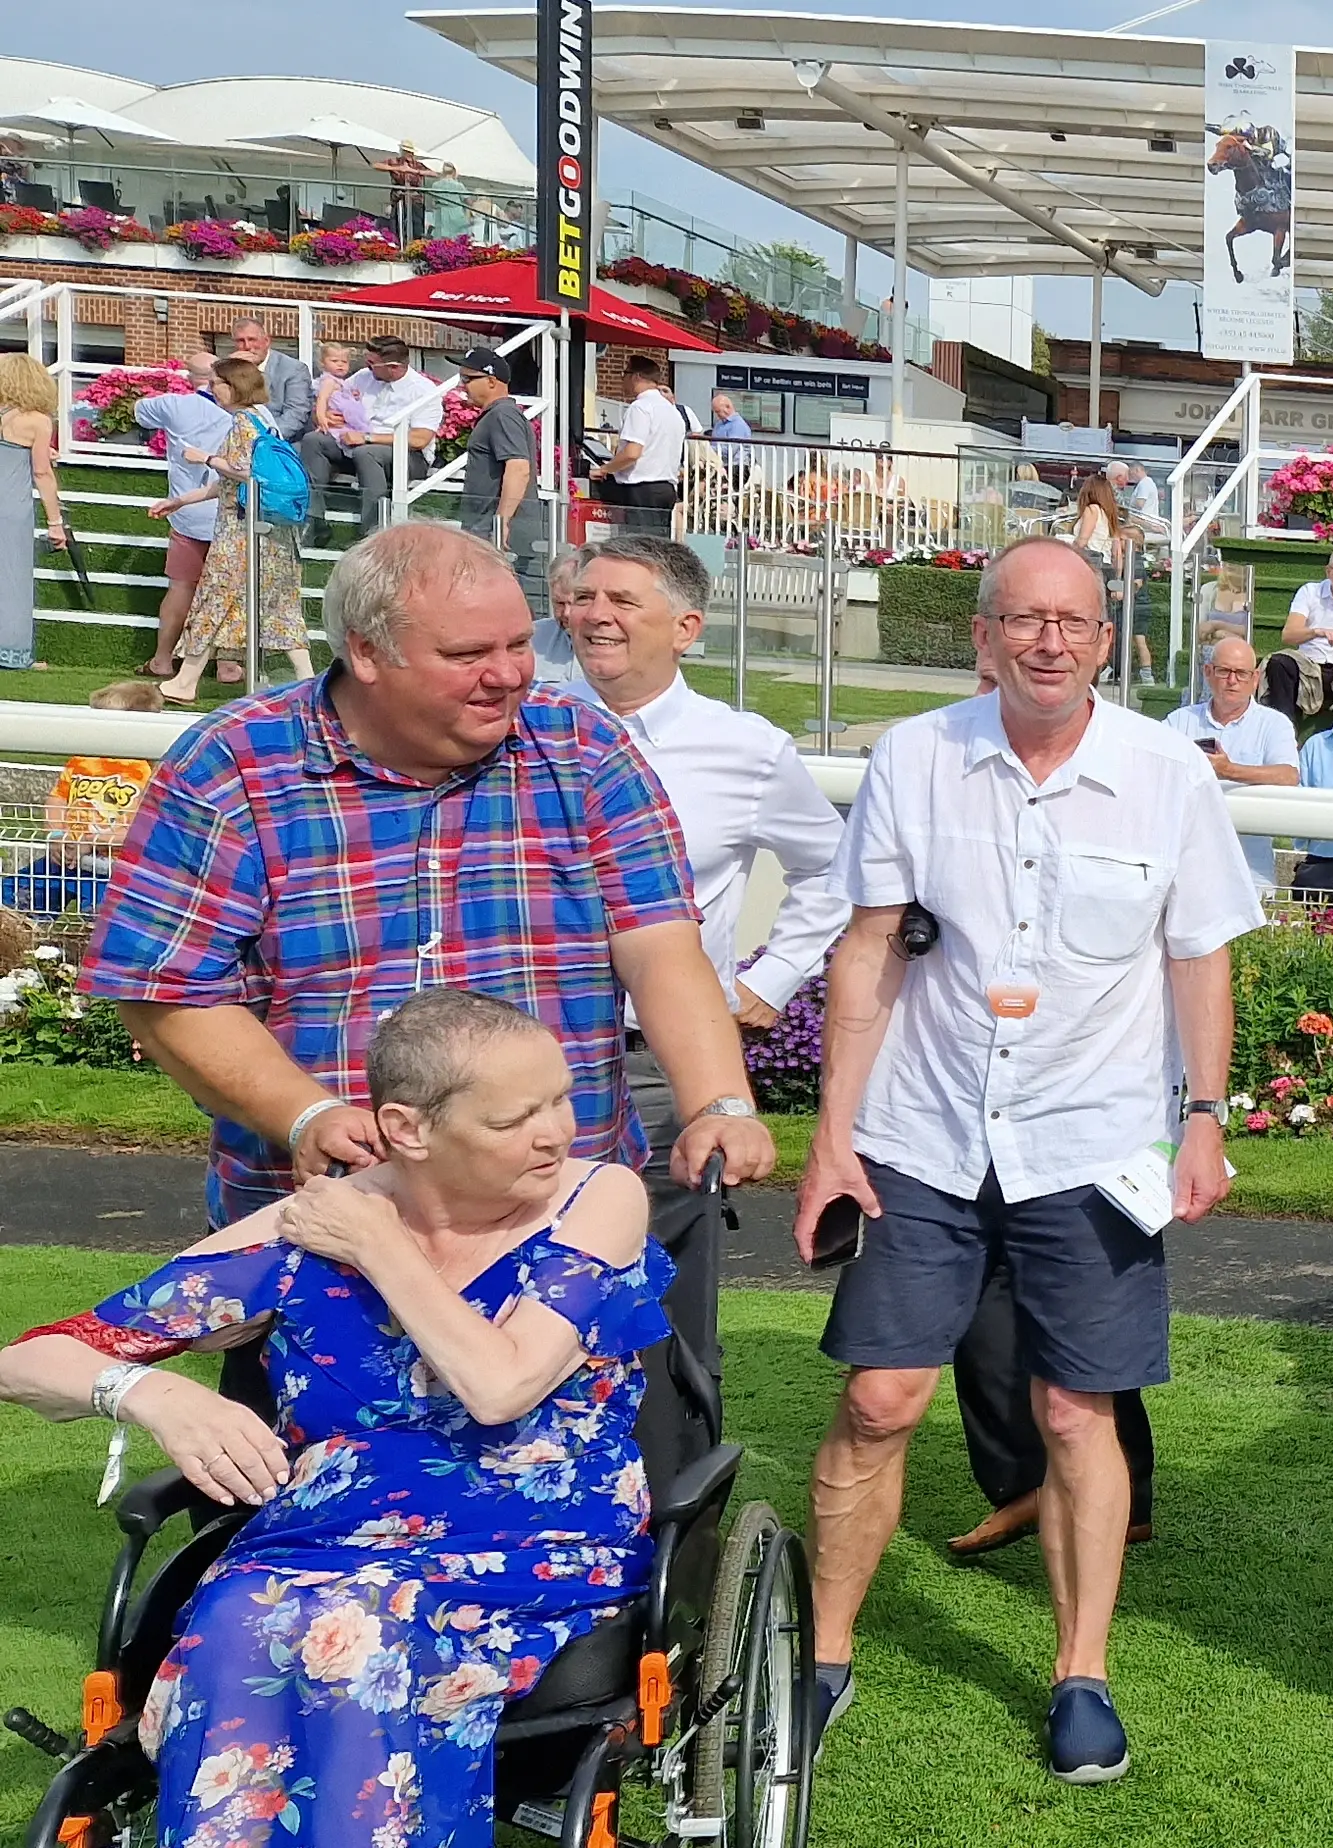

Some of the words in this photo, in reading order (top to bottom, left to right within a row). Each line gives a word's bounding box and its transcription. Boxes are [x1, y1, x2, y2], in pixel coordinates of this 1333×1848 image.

[558, 0, 584, 300] BETGOODWIN
[429, 290, 463, 301] Bet
[1259, 409, 1304, 427] ARR
